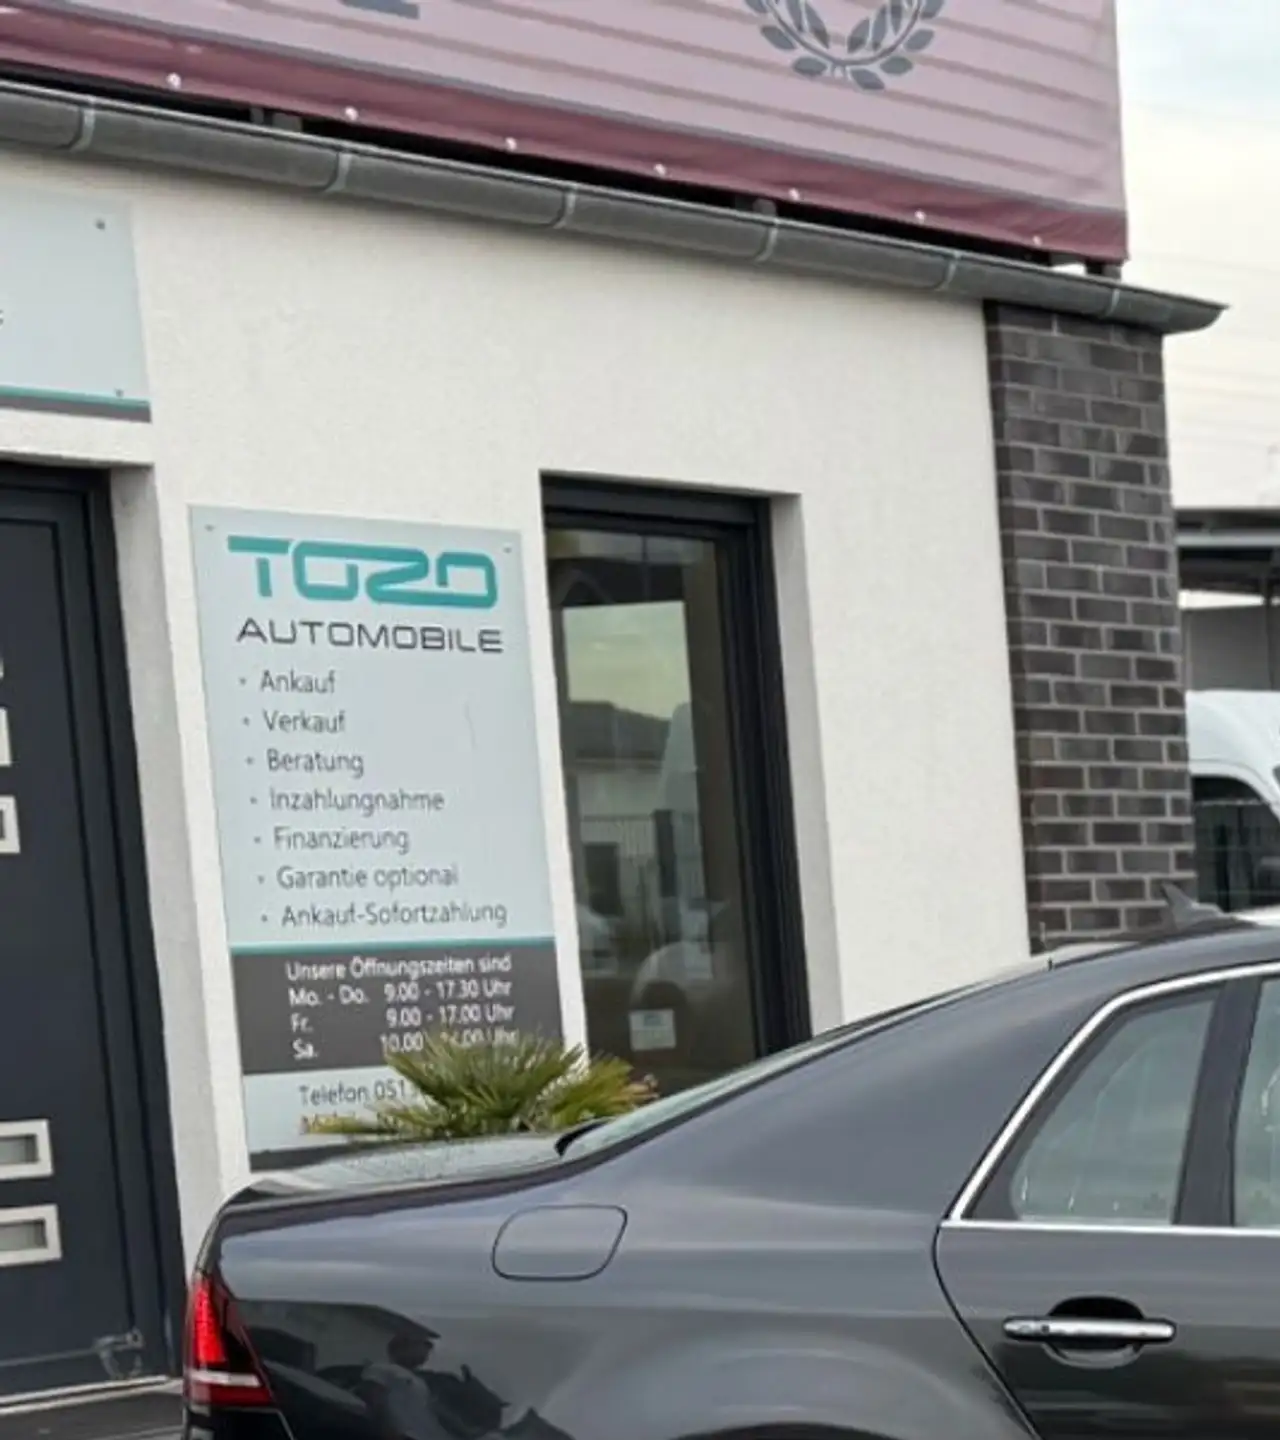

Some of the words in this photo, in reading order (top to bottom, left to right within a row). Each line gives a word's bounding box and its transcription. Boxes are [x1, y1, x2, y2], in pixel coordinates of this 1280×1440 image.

[227, 535, 498, 609] TOZO
[237, 618, 504, 653] AUTOMOBILE
[260, 670, 336, 694] Ankauf
[262, 709, 346, 734] Verkauf
[267, 748, 364, 778] Beratung
[270, 788, 445, 818] Inzahlungnahme
[274, 826, 410, 855] Finanzierung
[277, 866, 368, 890] Garantie
[374, 864, 459, 893] optional
[282, 902, 508, 928] Ankauf-Sofortzahlung
[285, 960, 347, 981] Unsere
[350, 955, 474, 980] Öffnungszeiten
[478, 953, 512, 973] sind
[288, 987, 322, 1007] Mo.
[338, 984, 369, 1005] Do.
[383, 981, 420, 1002] 9.00
[436, 979, 480, 999] 17.30
[482, 978, 512, 998] Uhr
[290, 1012, 314, 1033] Fr.
[386, 1007, 422, 1028] 9.00
[439, 1004, 482, 1025] 17.00
[484, 1003, 515, 1022] Uhr
[292, 1038, 319, 1060] Sa.
